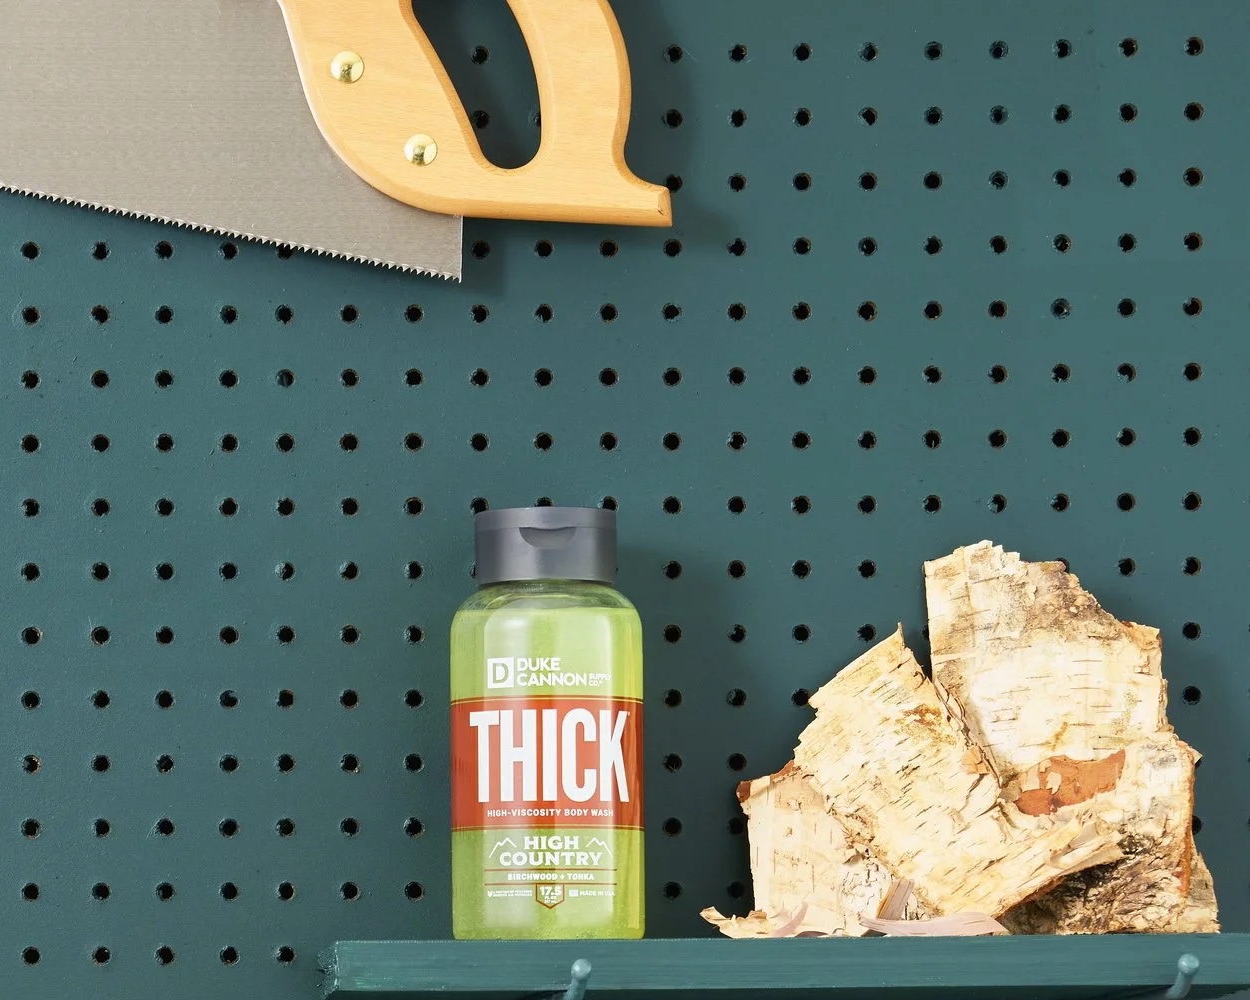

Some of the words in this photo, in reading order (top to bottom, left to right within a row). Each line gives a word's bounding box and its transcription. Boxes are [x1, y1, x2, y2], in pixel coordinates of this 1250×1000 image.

[517, 657, 561, 671] DUKE
[517, 673, 587, 686] CANNON
[470, 708, 630, 803] THICK
[487, 808, 561, 817] HIGH-VISCOSITY
[591, 809, 614, 817] WASH
[523, 836, 579, 850] HIGH
[499, 852, 602, 866] COUNTRY
[507, 873, 557, 881] BIRCHWOOD
[567, 873, 594, 881] TONKA
[540, 886, 562, 896] 17.5
